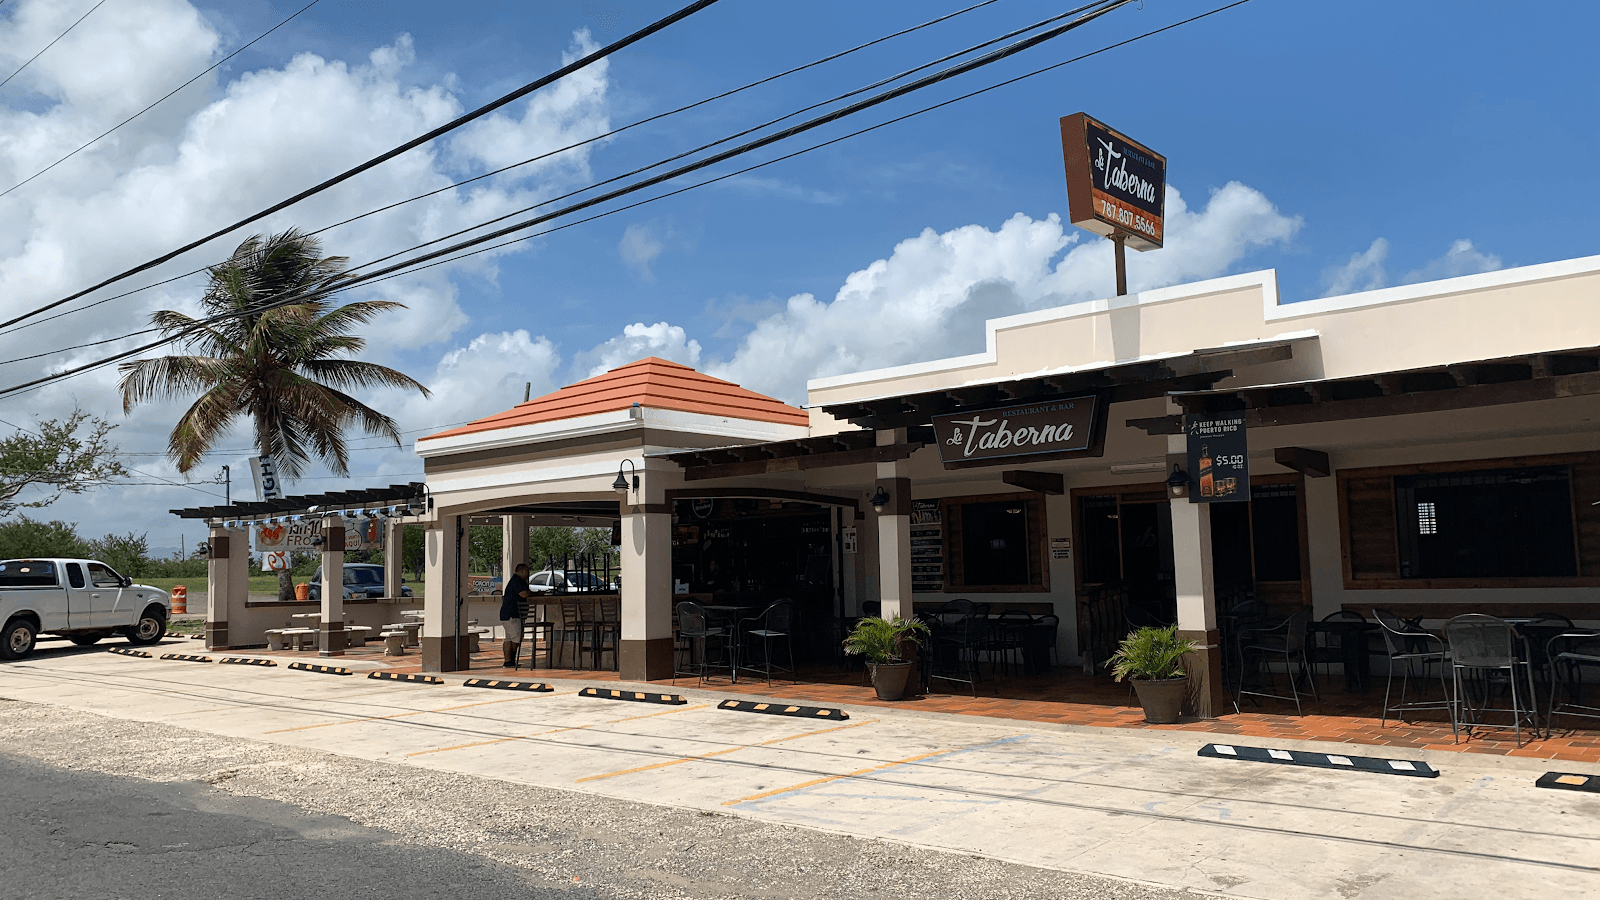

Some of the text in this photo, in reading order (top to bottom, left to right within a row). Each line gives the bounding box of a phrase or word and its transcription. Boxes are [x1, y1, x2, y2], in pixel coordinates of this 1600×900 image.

[1096, 136, 1156, 204] Taberna
[1101, 200, 1156, 236] 787.807.5566
[1002, 406, 1050, 418] RESTAURANT
[1058, 402, 1075, 410] BAR
[1214, 418, 1242, 427] WALKING
[946, 416, 1074, 457] La Taberna
[1216, 454, 1244, 466] $5.00
[287, 536, 312, 546] FRO
